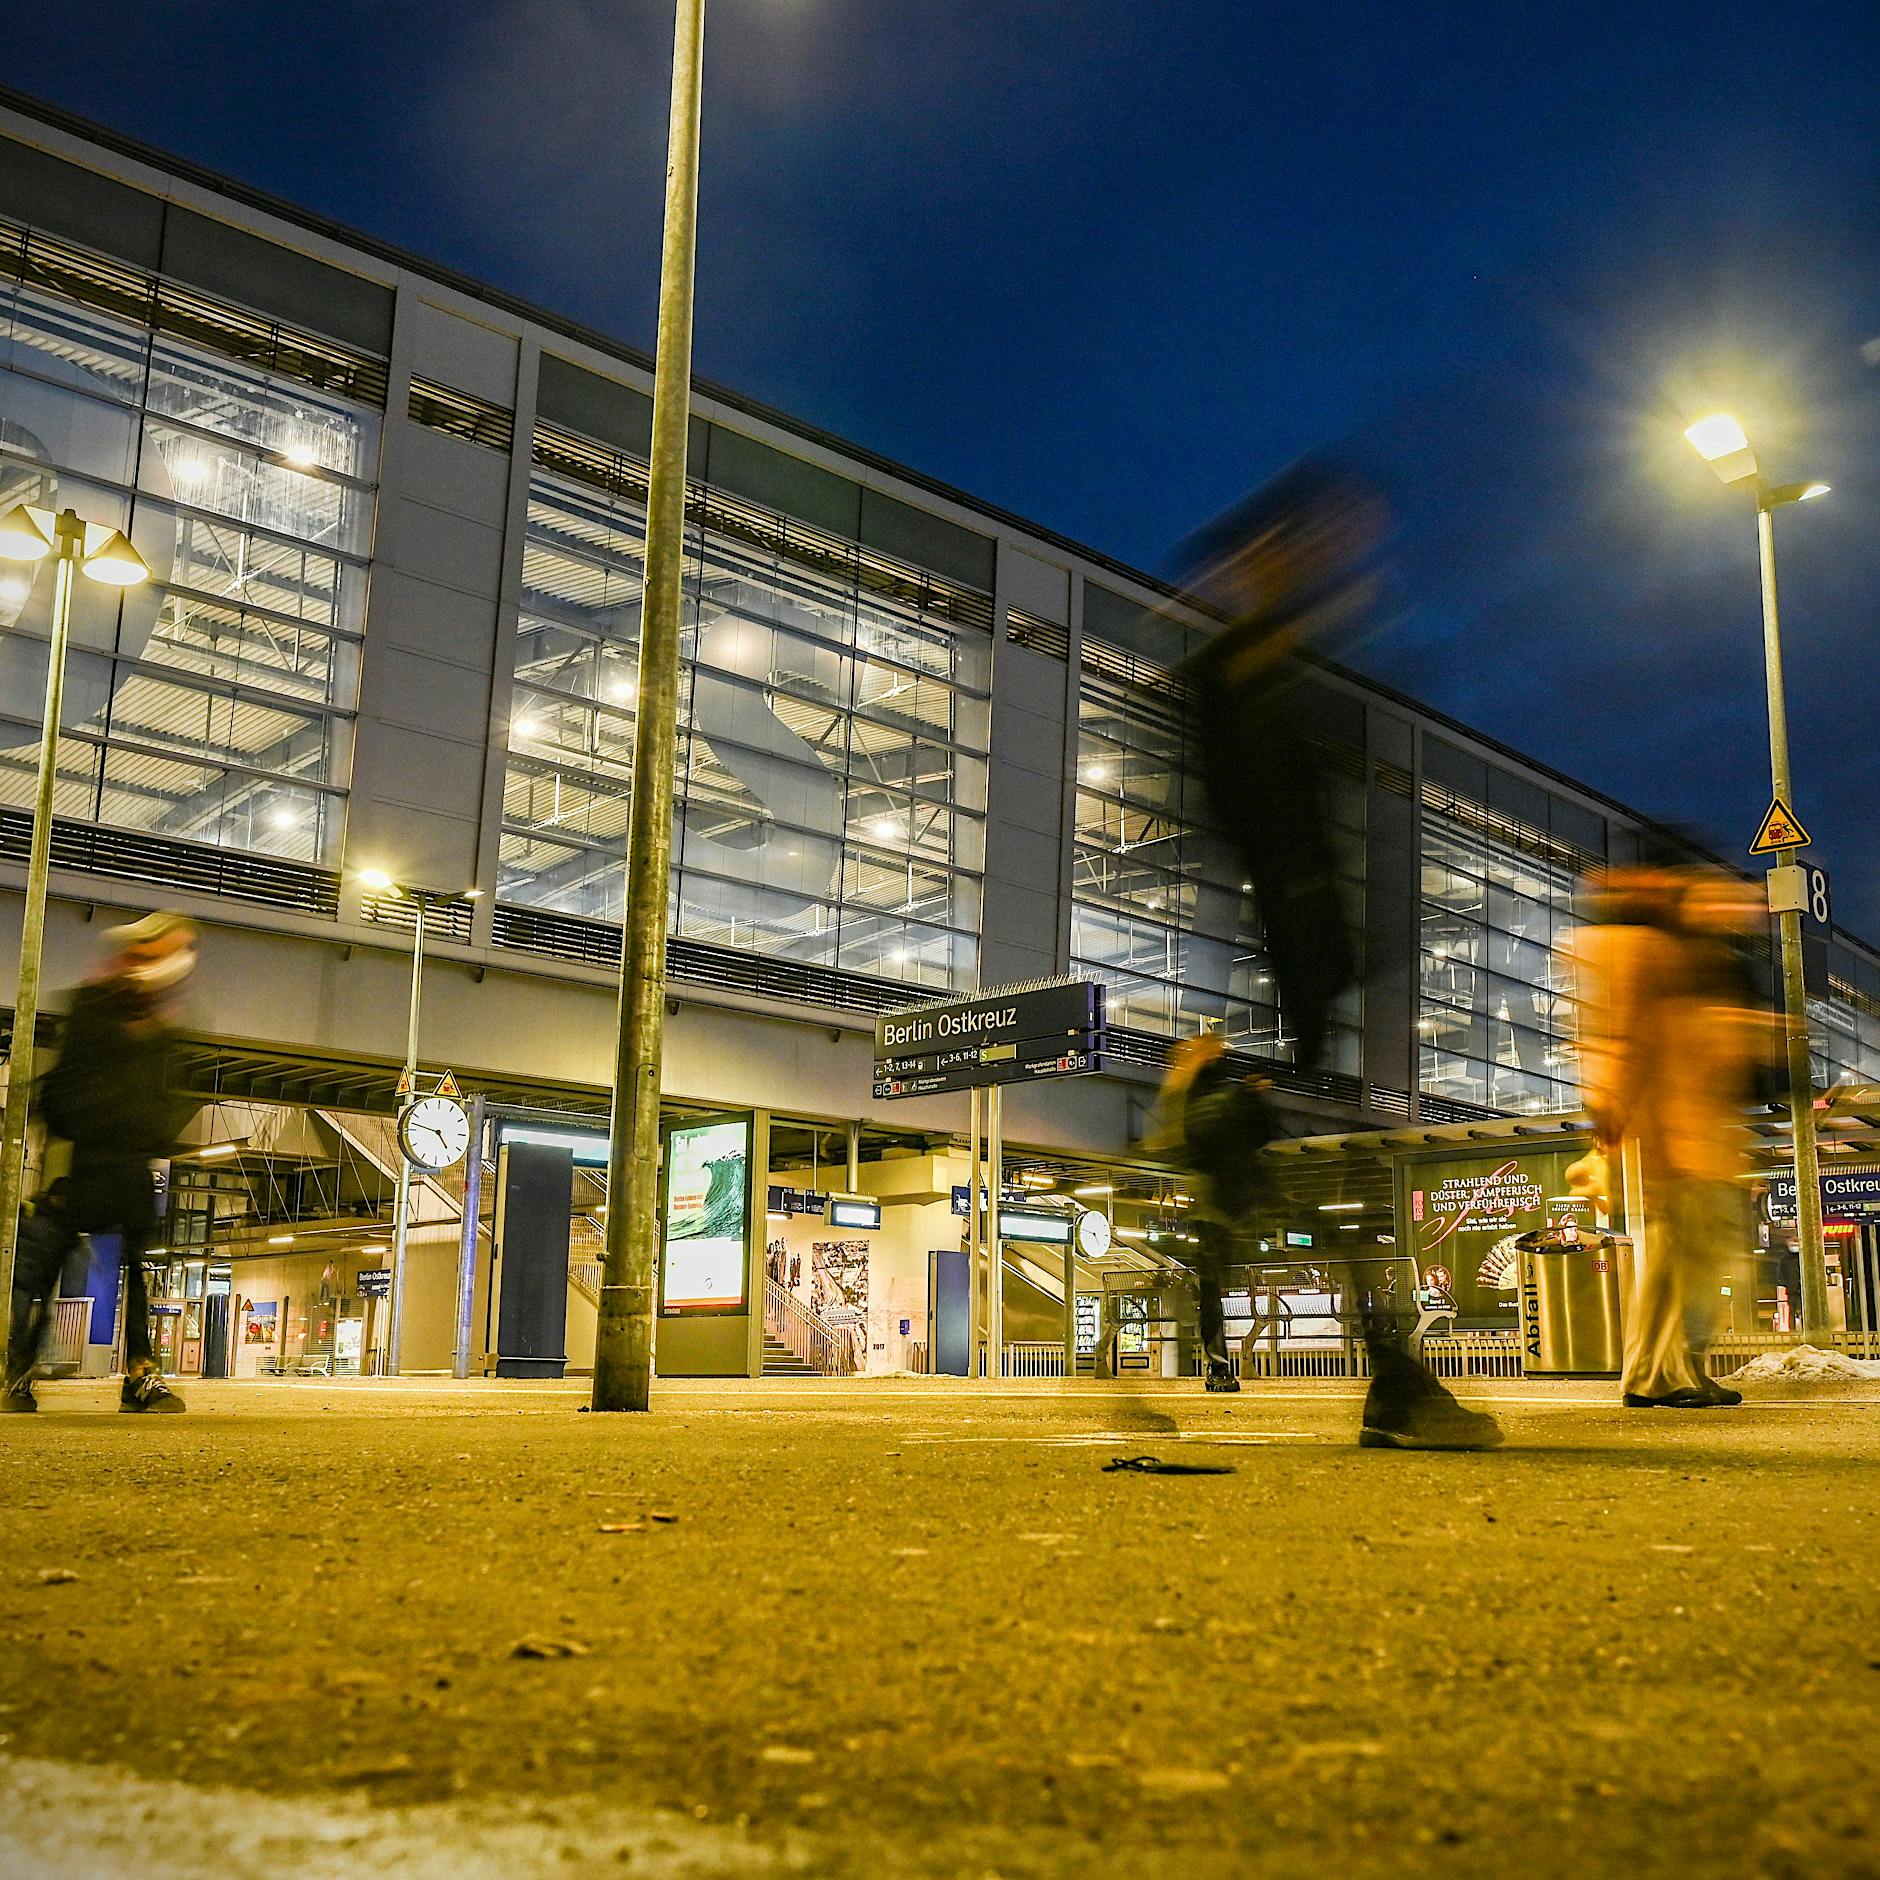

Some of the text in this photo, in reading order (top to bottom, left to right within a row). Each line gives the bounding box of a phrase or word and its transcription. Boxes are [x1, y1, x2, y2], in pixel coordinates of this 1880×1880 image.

[1812, 869, 1828, 923] 8
[884, 1007, 1017, 1046] Berlin Ostkreuz
[901, 1060, 916, 1070] 13-14
[949, 1053, 962, 1063] 3-6,
[962, 1050, 978, 1060] 11-12
[1442, 1174, 1529, 1189] STRAHLEND UND
[1432, 1196, 1541, 1213] UND VERFÜHRERISCH
[1594, 1262, 1608, 1271] DB
[1524, 1284, 1541, 1358] Abfall
